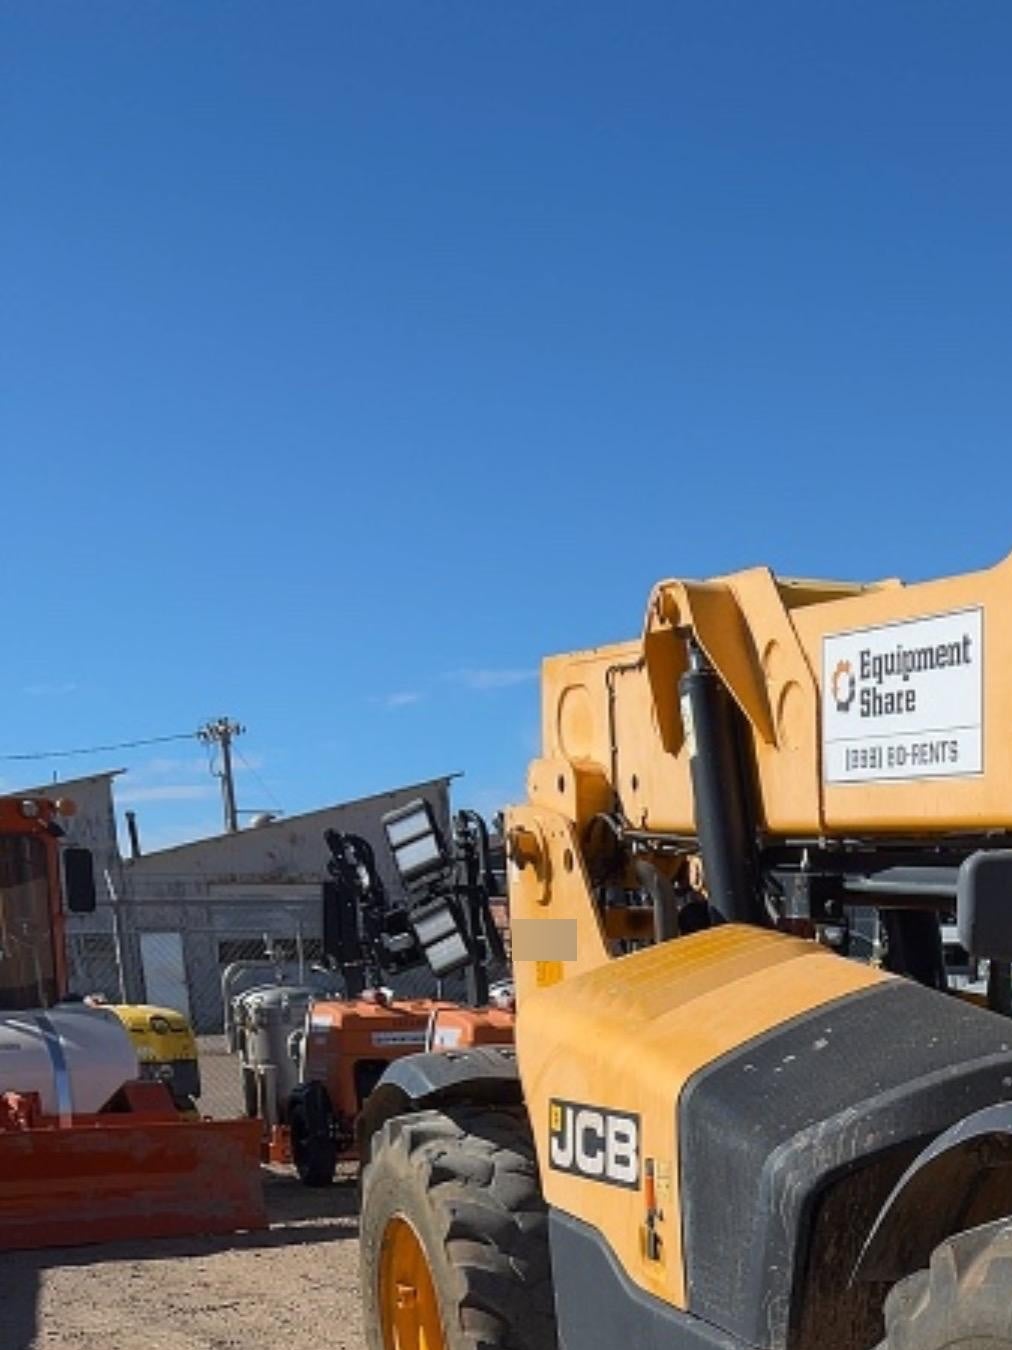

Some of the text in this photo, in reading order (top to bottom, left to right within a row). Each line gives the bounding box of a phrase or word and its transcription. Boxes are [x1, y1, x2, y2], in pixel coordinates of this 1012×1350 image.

[860, 634, 972, 684] Equipment
[860, 687, 916, 717] Share
[551, 1106, 639, 1182] JCB
